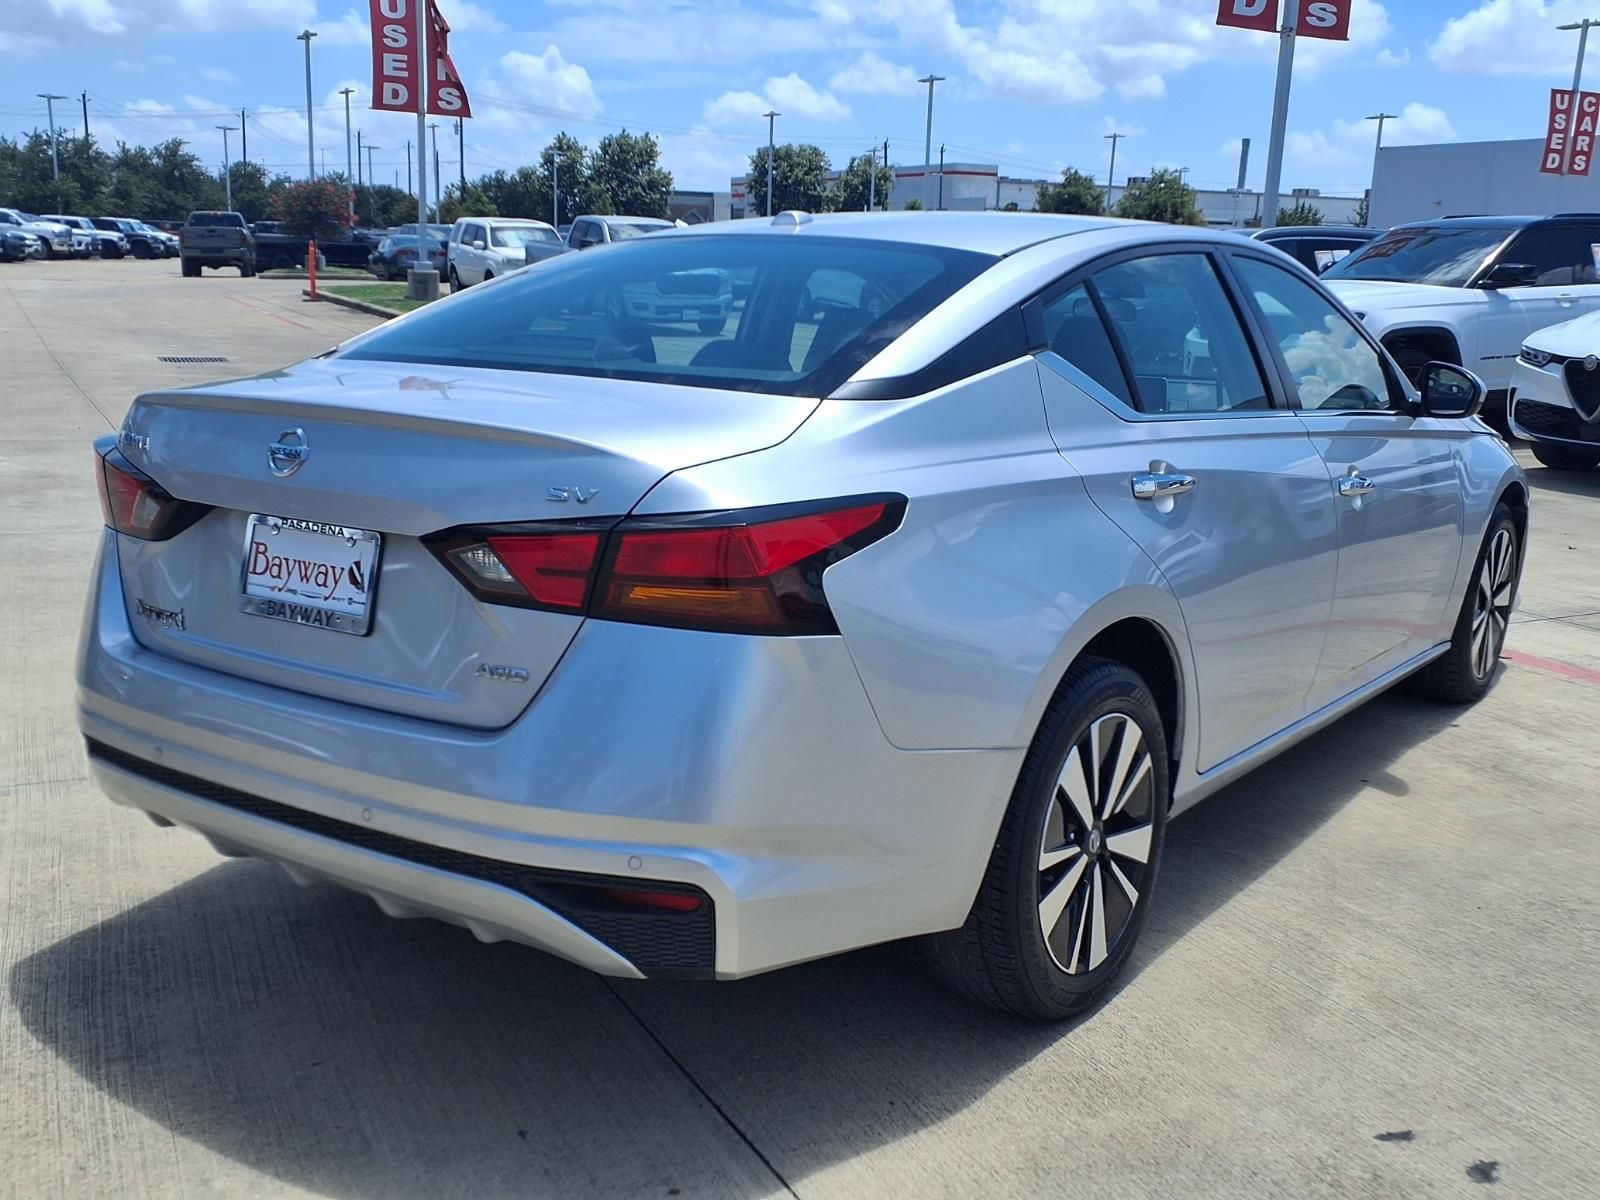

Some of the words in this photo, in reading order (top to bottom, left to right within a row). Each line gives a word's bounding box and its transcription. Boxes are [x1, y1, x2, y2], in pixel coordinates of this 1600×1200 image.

[380, 0, 409, 106] USED
[1545, 93, 1570, 169] USED
[1572, 96, 1597, 171] CARS
[546, 486, 599, 504] SV
[281, 519, 345, 537] PASADENA
[248, 541, 345, 601] Bayway
[265, 600, 335, 627] BAYWAY
